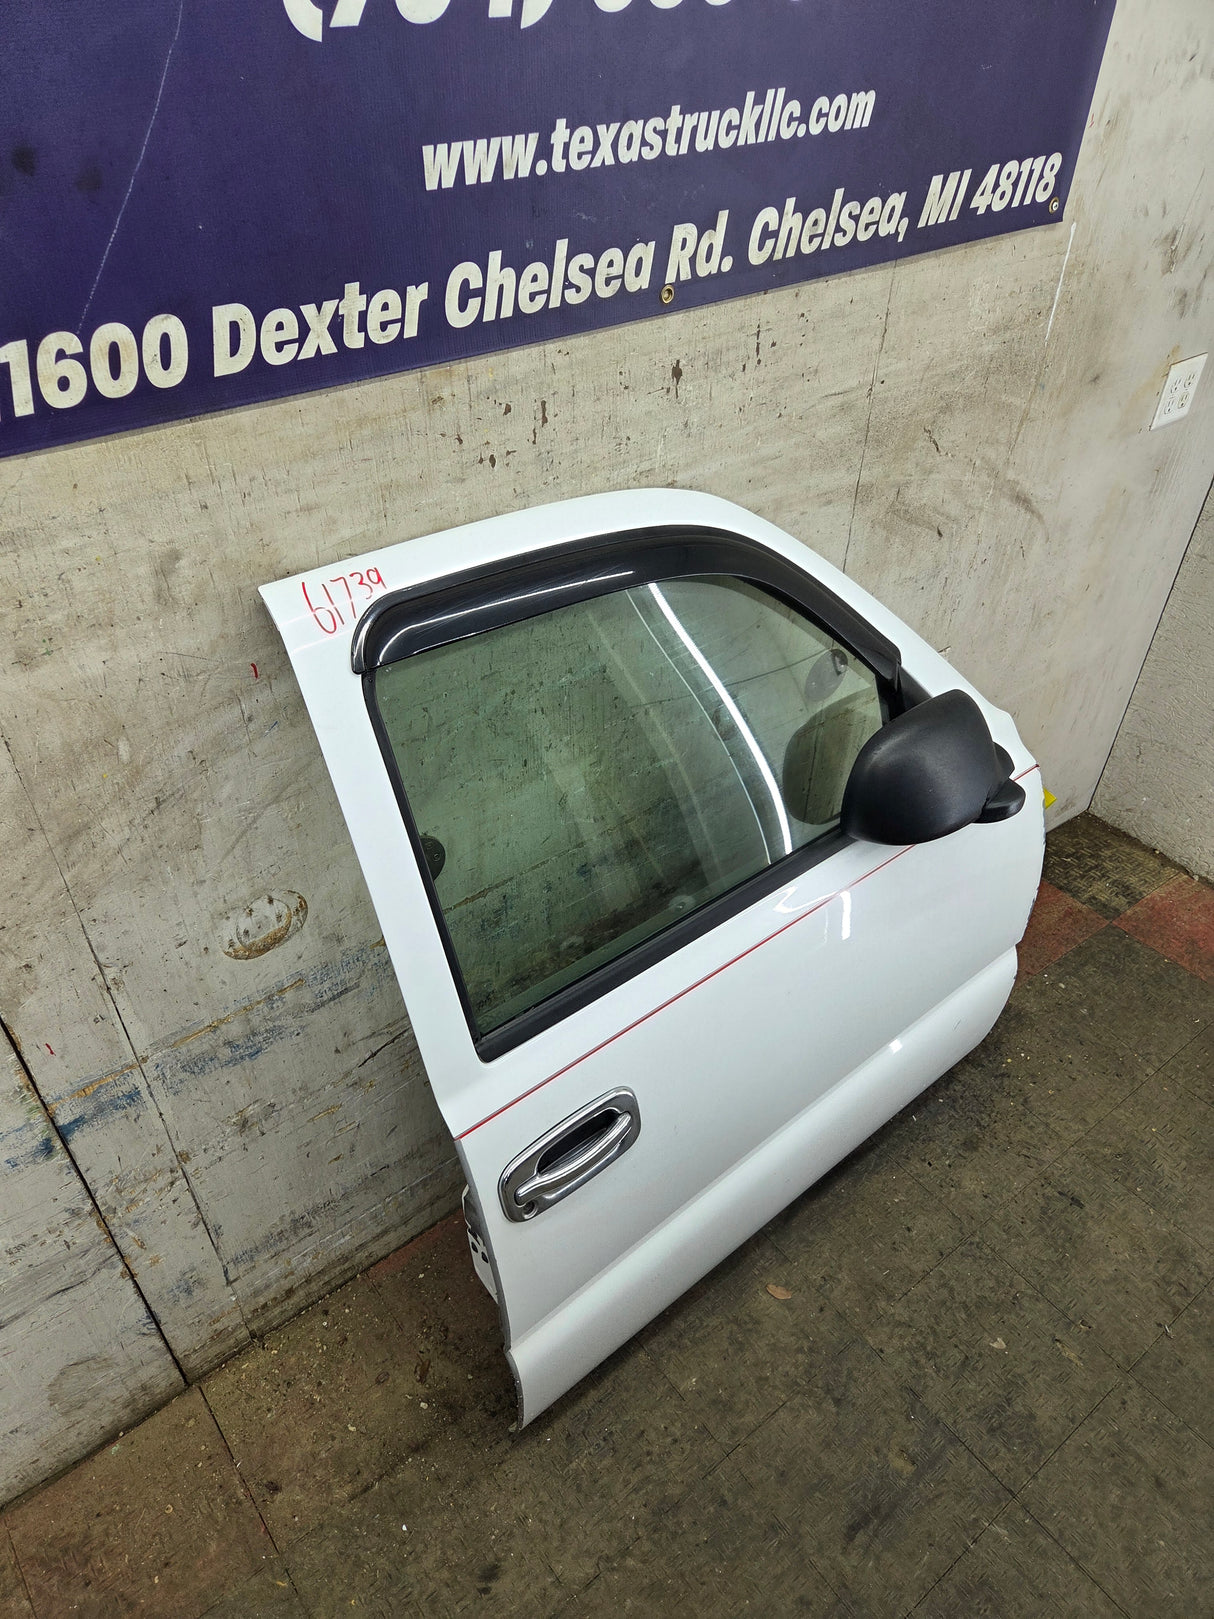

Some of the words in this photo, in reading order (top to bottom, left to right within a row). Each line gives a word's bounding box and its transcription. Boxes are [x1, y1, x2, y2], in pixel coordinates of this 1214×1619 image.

[422, 88, 876, 191] www.texastruckllc.com
[212, 282, 430, 378] Dexter
[444, 238, 656, 330] Chelsea
[665, 210, 733, 286] Rd.
[748, 187, 908, 272] Chelsea,
[917, 171, 973, 229] MI
[971, 152, 1063, 216] 48118
[302, 567, 388, 634] 61739
